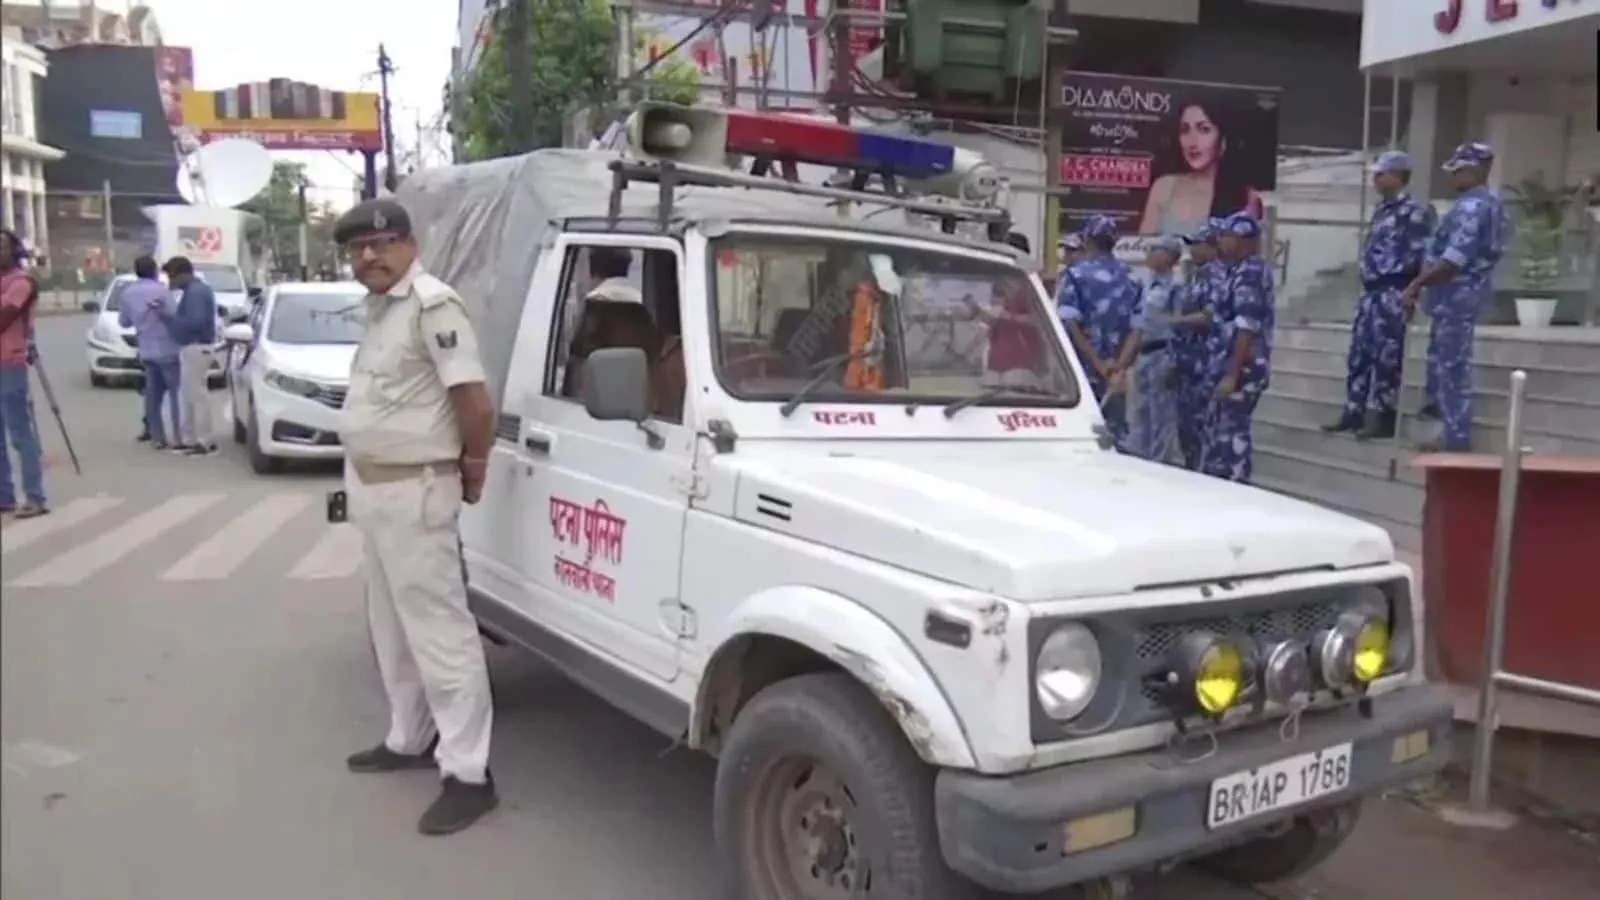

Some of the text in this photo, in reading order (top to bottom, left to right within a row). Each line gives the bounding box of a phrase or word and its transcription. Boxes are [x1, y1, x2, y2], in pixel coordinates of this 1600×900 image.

[1061, 85, 1171, 113] DIAMONDS
[811, 410, 877, 426] पटना
[549, 496, 626, 566] पटना पुलिस
[1300, 754, 1347, 798] 1786
